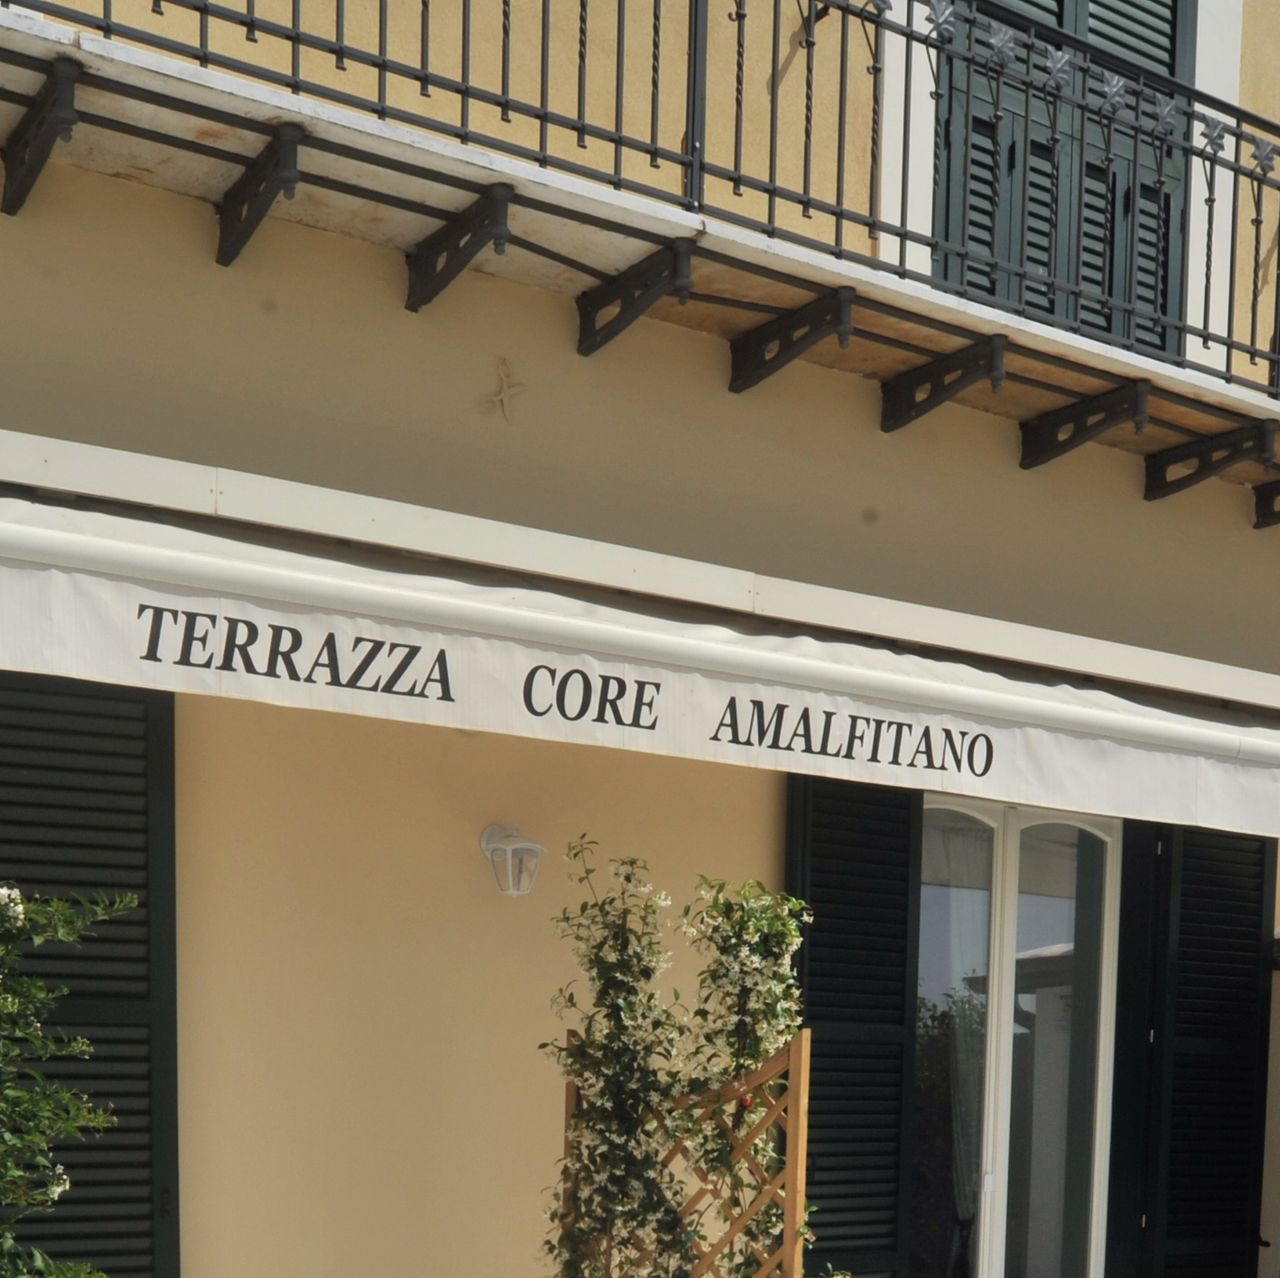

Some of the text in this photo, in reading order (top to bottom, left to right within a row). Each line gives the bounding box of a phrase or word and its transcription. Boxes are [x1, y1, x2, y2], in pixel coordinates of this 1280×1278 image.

[137, 603, 994, 777] TERRAZZA CORE AMALFITANO
